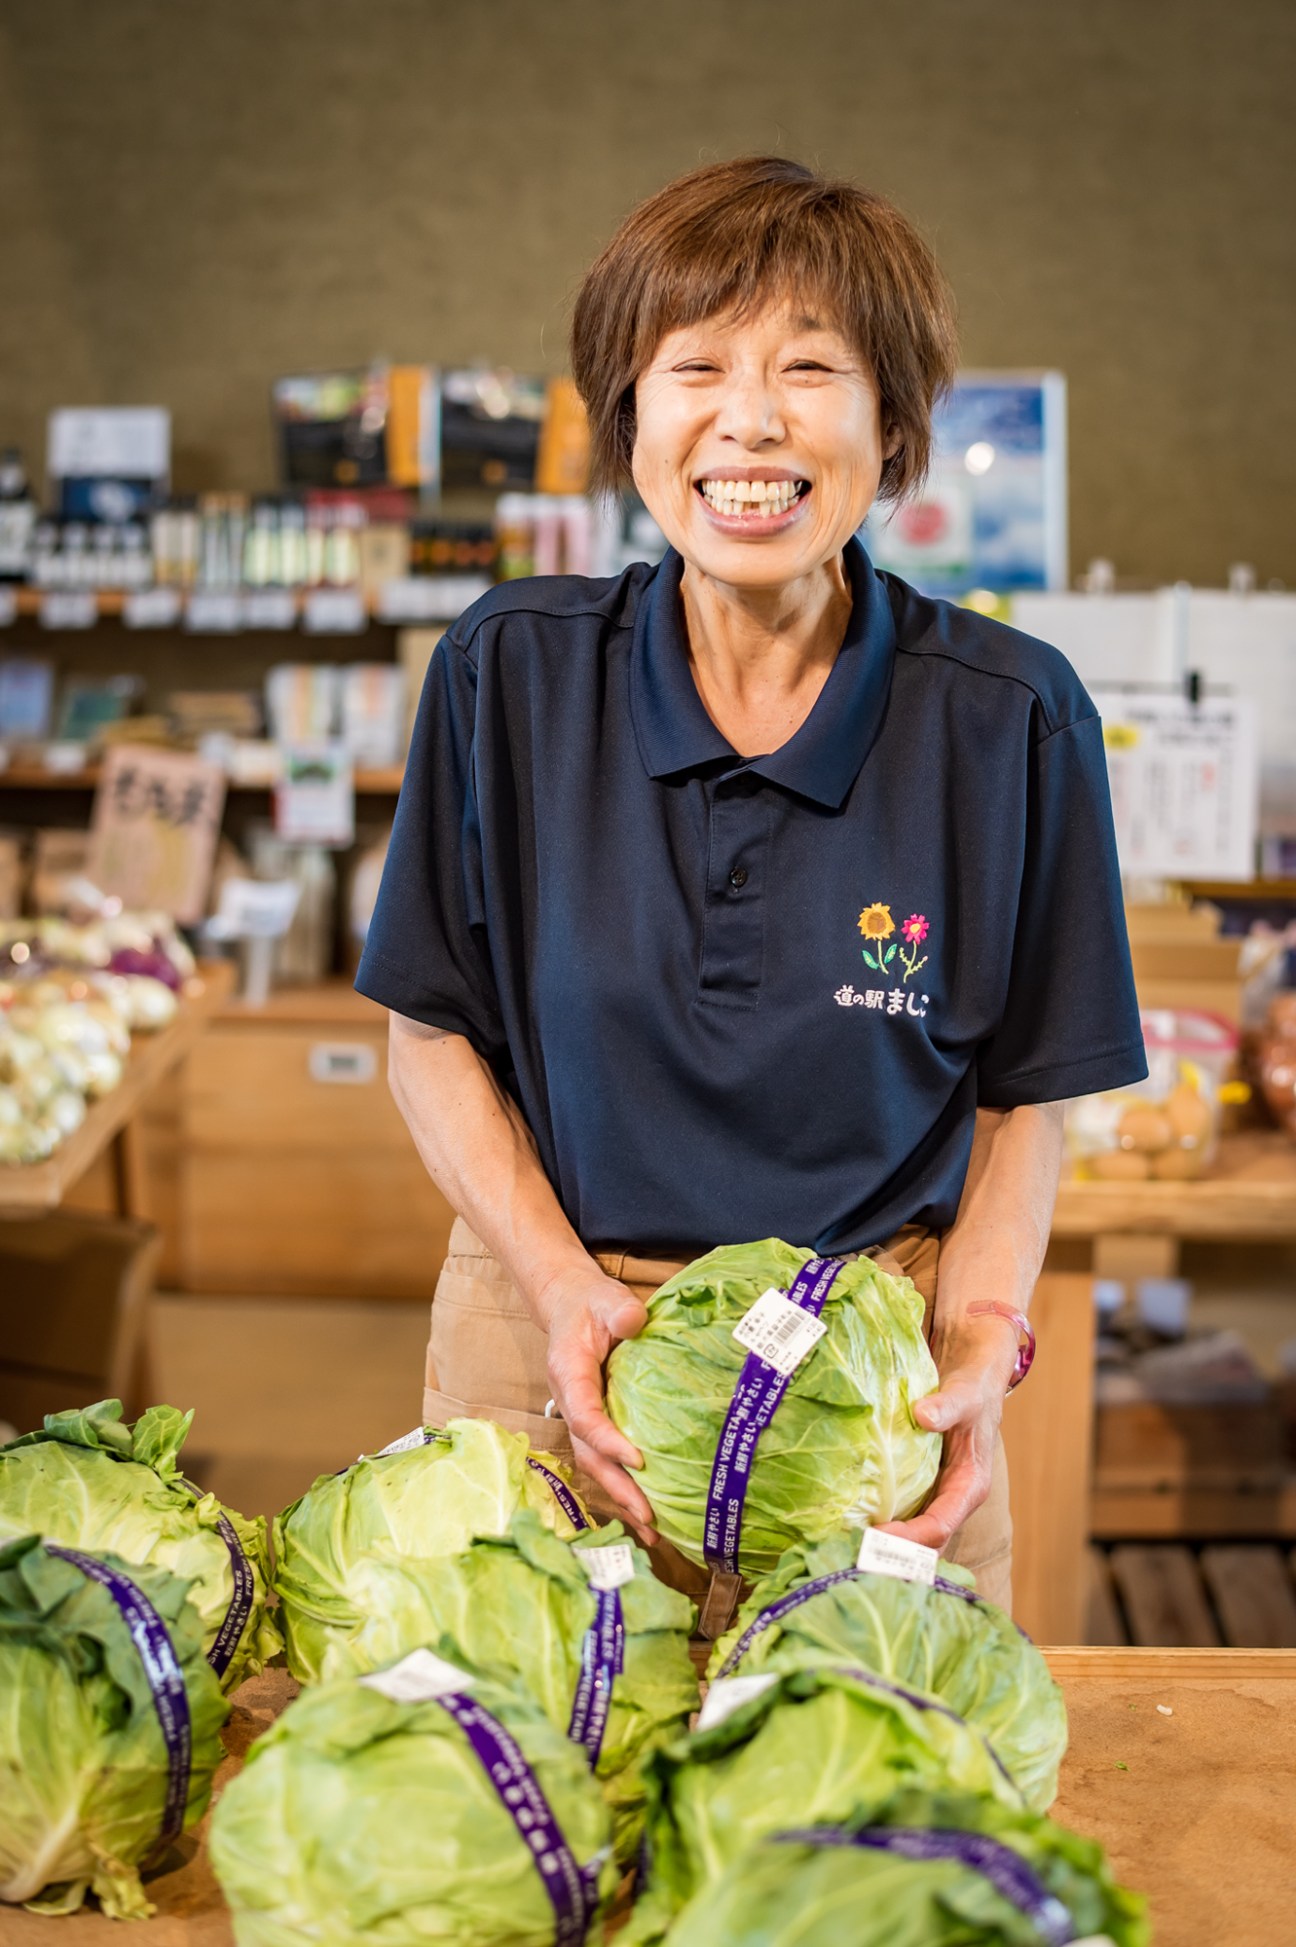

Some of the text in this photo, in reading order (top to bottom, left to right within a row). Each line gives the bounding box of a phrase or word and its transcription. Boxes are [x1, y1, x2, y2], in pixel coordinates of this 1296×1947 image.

[811, 1279, 829, 1302] FRESH
[712, 1464, 730, 1501] FRESH
[706, 1508, 721, 1549] 新鮮やさい
[723, 1498, 740, 1559] VEGETABLES
[219, 1570, 243, 1650] VEGETABLES
